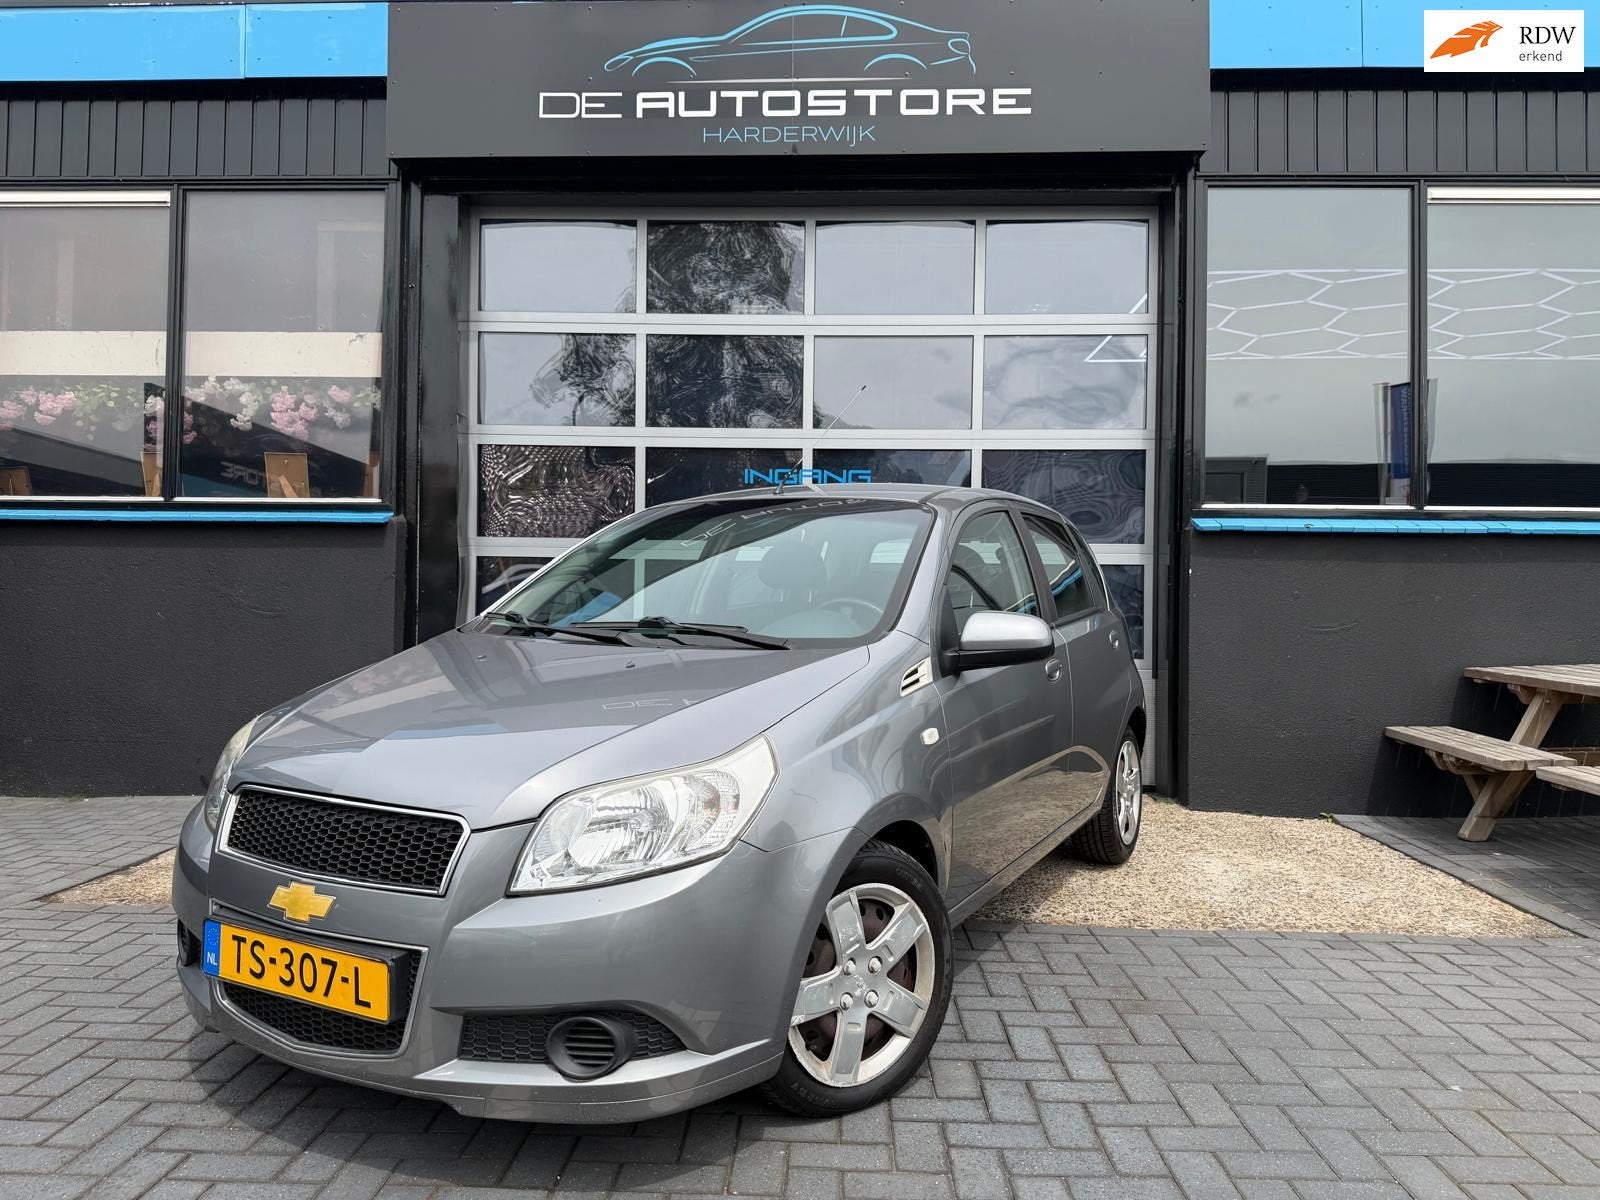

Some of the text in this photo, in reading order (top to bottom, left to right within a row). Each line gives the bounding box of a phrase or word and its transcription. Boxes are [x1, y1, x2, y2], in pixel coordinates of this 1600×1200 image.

[538, 88, 1032, 119] DE AUTOSTORE
[703, 125, 876, 147] HARDERWIJK
[744, 468, 872, 484] INGANG
[206, 951, 218, 966] NL
[231, 934, 371, 1009] TS-307-L
